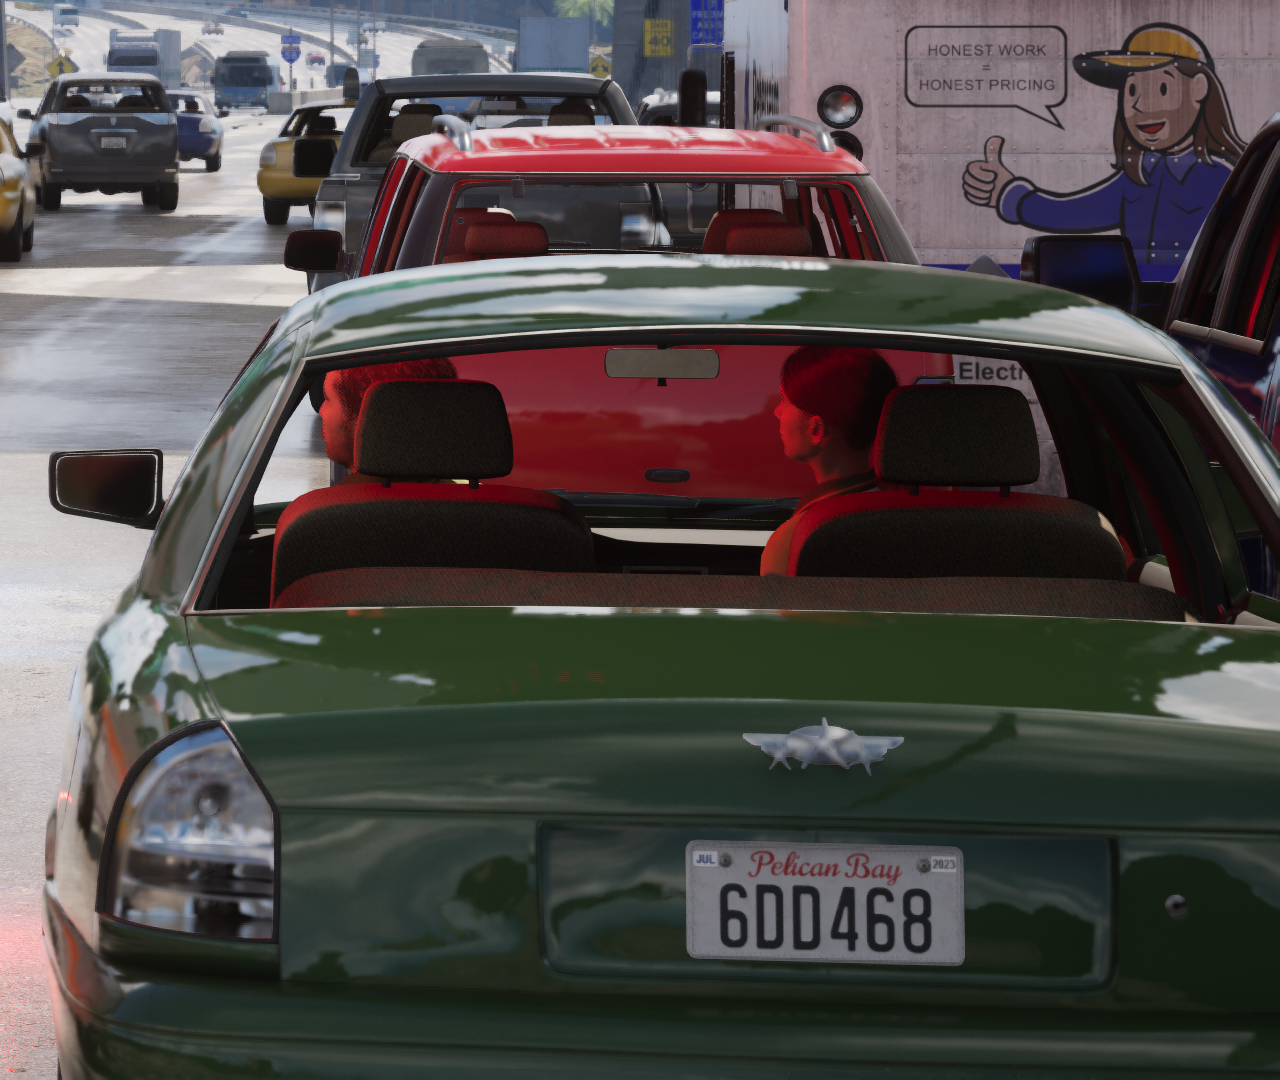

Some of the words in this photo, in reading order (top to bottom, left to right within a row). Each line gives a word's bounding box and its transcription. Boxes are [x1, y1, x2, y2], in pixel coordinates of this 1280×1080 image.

[928, 44, 993, 57] HONEST
[998, 44, 1047, 57] WORK
[919, 79, 984, 91] HONEST
[989, 79, 1055, 91] PRICING
[696, 854, 716, 865] JUL
[748, 850, 841, 878] Pelican
[844, 853, 903, 886] Bay
[932, 858, 957, 870] 2023
[719, 883, 933, 953] 6DD468
